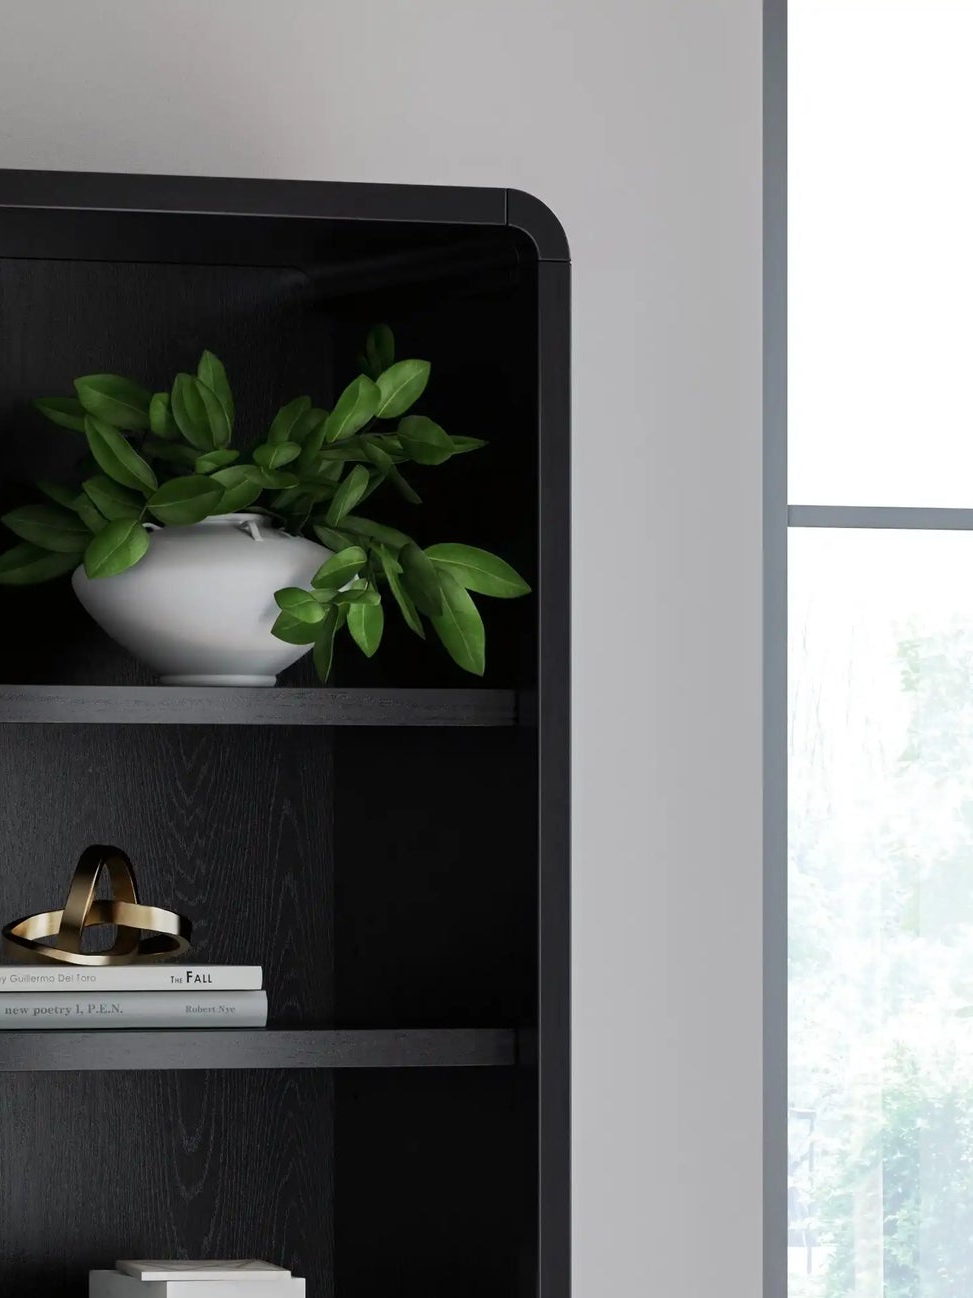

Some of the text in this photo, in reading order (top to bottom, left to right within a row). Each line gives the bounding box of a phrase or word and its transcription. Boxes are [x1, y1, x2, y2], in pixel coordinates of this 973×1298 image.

[9, 974, 55, 983] Guillermo
[57, 974, 74, 983] Del
[76, 974, 97, 982] Toro
[186, 971, 213, 984] FALL
[4, 1006, 29, 1015] new
[32, 1005, 72, 1017] poetry
[87, 1003, 124, 1014] P.E.N.
[185, 1004, 236, 1015] Robert Nye
